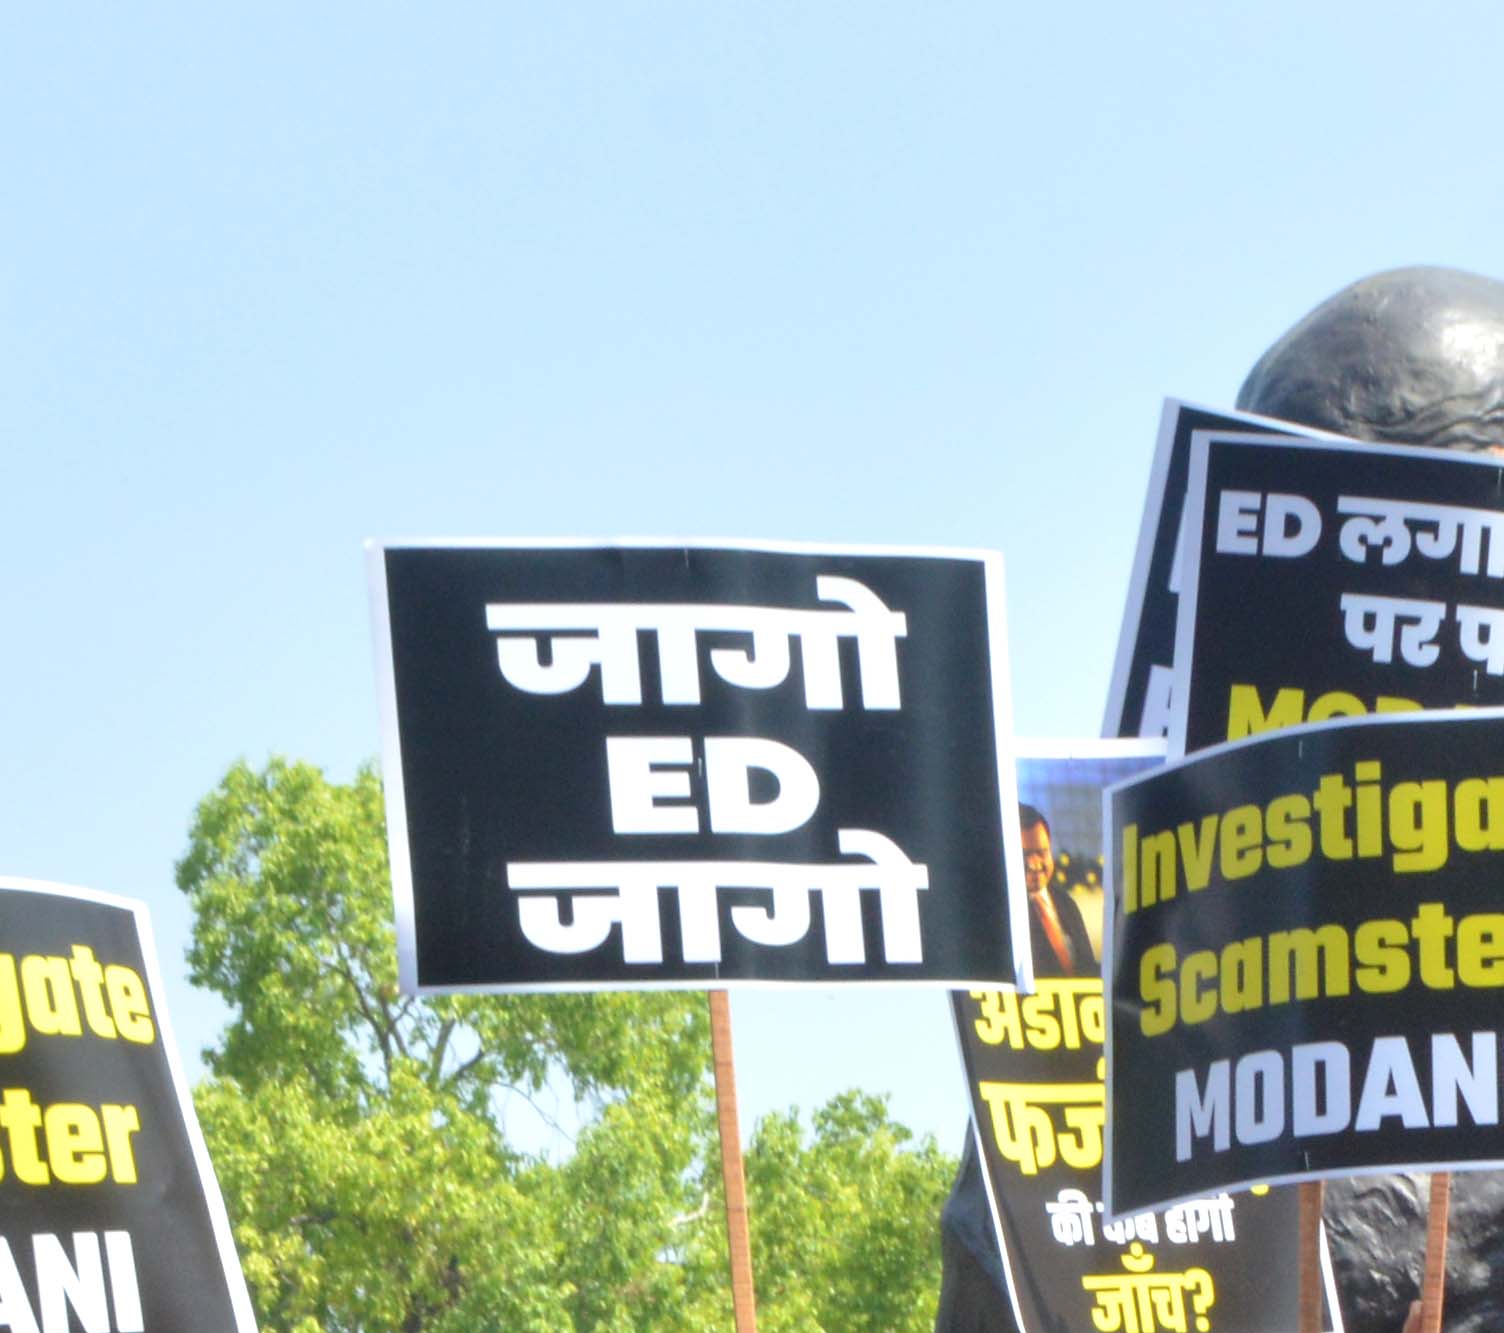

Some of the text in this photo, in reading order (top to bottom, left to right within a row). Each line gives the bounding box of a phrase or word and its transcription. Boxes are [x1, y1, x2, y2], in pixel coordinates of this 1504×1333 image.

[1216, 490, 1321, 558] ED
[485, 574, 909, 711] जागो
[1341, 593, 1446, 667] पर
[606, 736, 821, 835] ED
[506, 828, 930, 964] जागो
